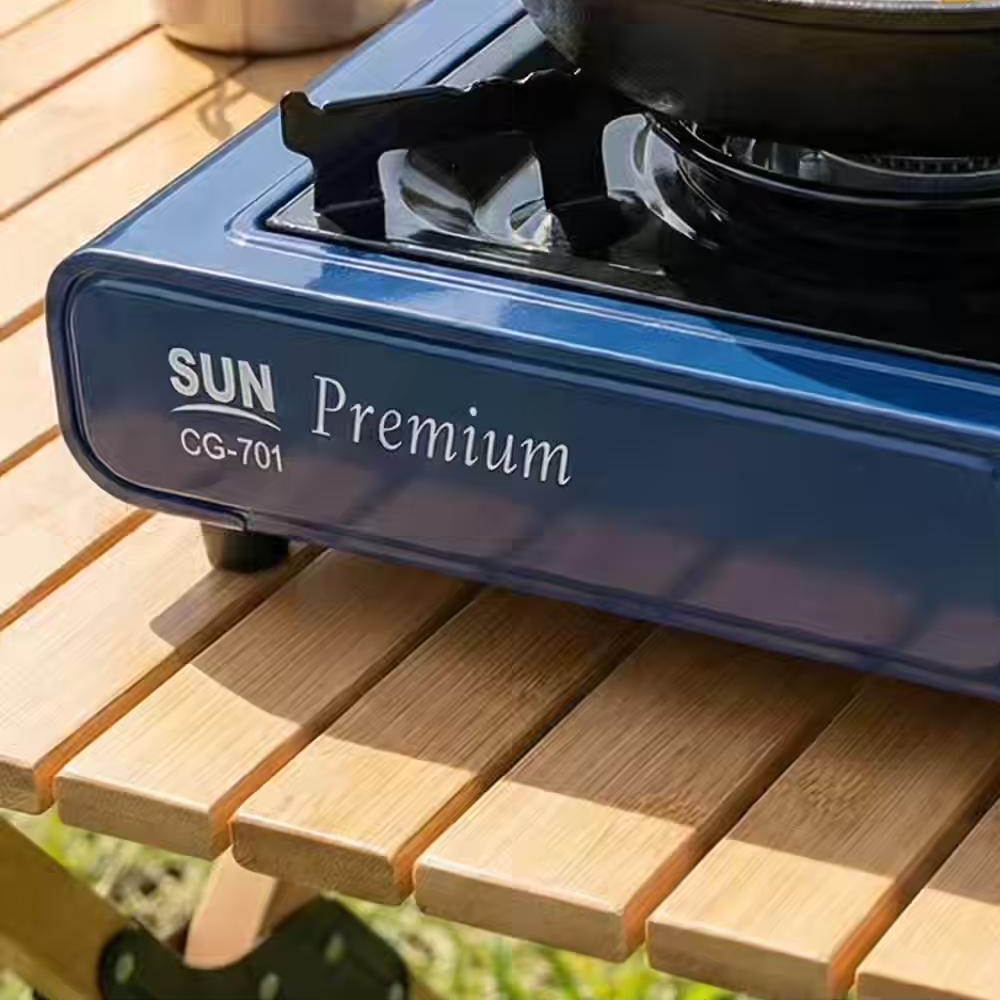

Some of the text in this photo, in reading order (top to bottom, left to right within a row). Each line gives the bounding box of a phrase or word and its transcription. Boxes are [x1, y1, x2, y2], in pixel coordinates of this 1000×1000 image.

[168, 347, 275, 412] SUN
[180, 428, 284, 473] CG-701
[311, 374, 571, 486] Premium
